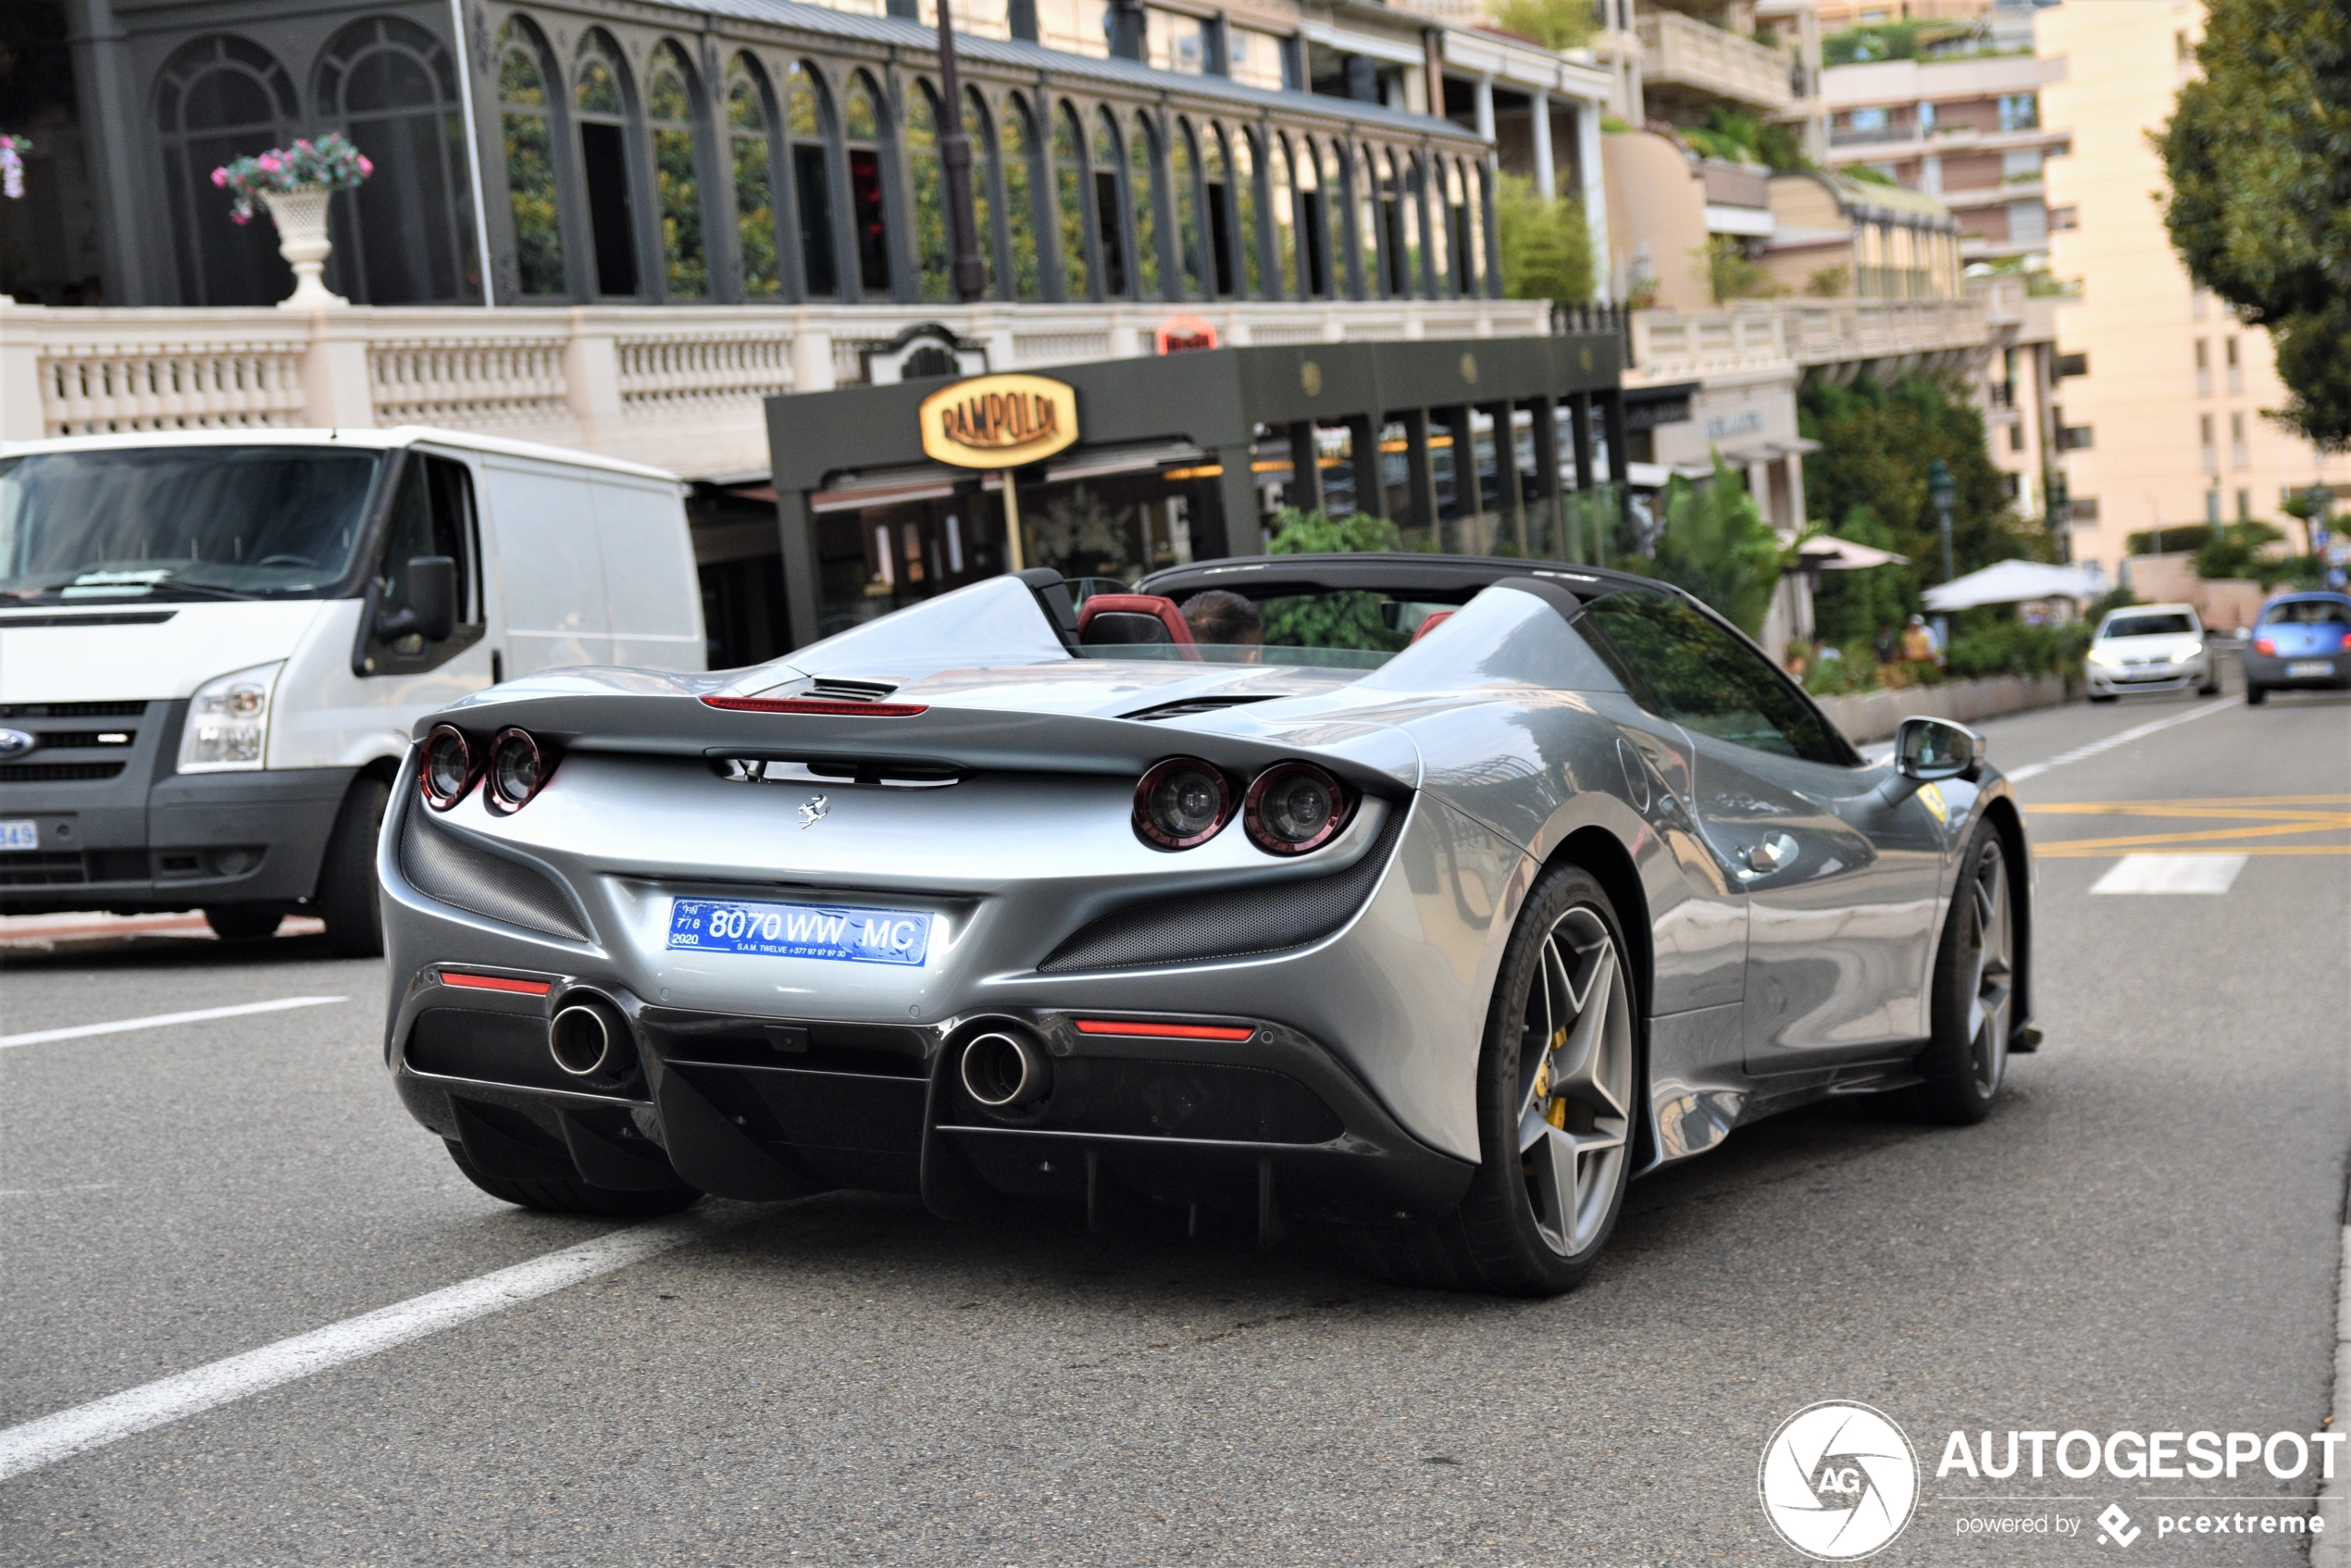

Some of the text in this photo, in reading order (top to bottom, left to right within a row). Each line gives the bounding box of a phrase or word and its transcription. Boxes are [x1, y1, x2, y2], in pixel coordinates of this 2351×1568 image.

[685, 906, 698, 915] FIN
[709, 910, 915, 950] 8070 WW MC
[672, 933, 699, 945] 2020
[737, 943, 757, 952] S.A.M.
[760, 944, 788, 953] TWELVE
